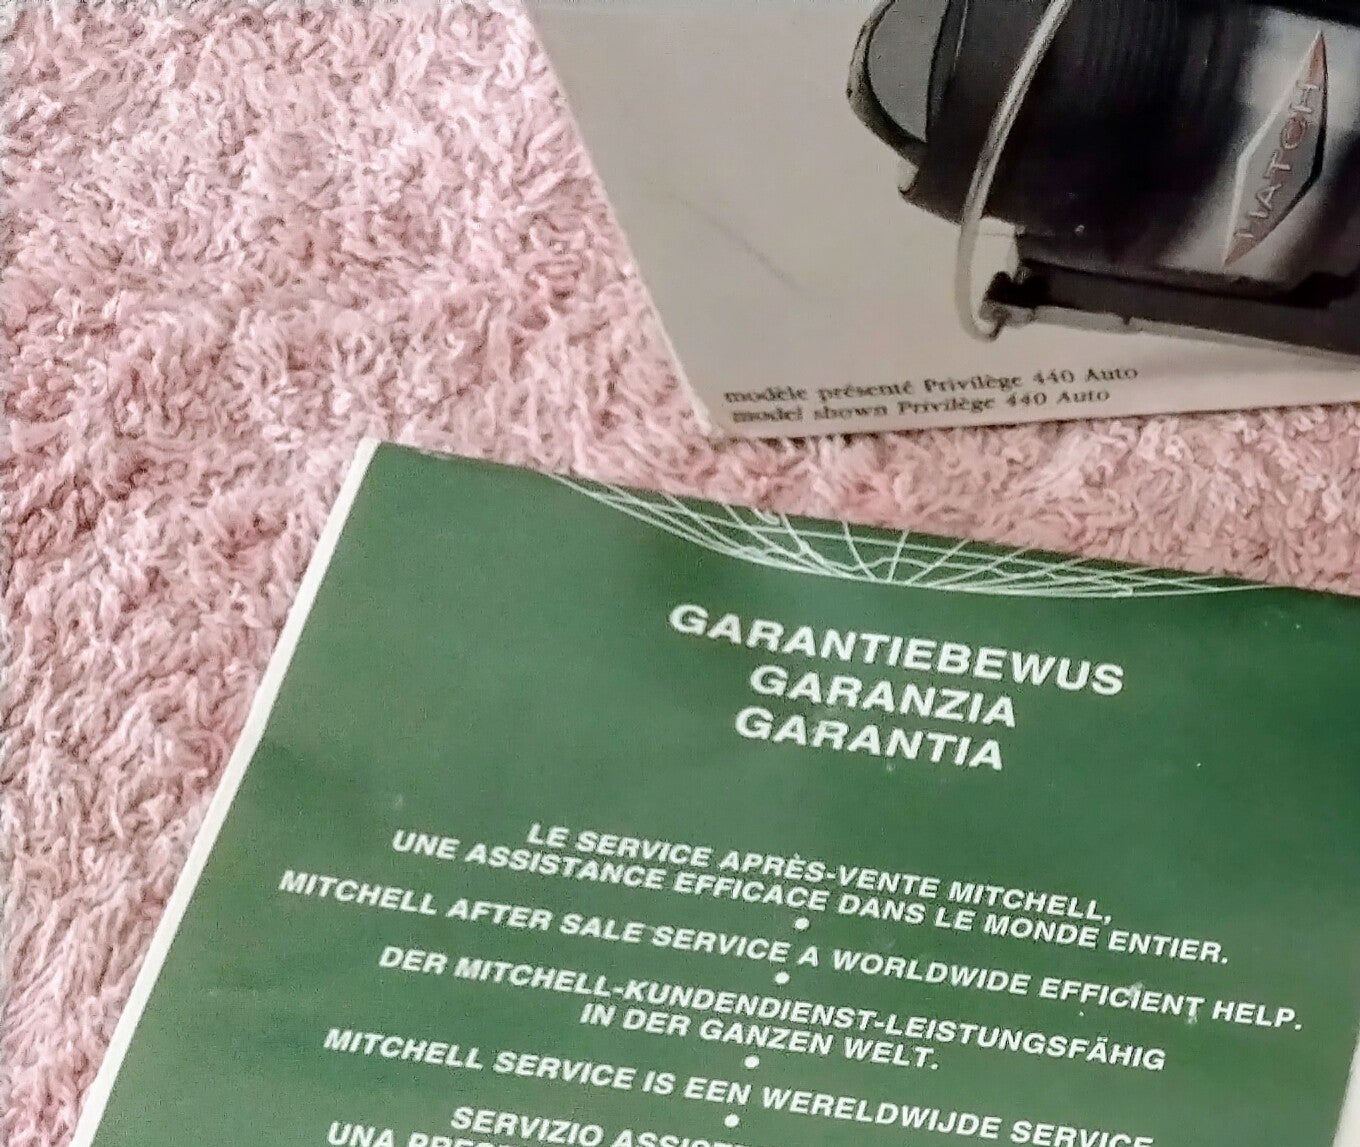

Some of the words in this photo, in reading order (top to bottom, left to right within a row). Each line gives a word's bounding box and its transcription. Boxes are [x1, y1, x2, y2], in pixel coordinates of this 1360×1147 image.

[923, 373, 1024, 393] Privilège
[1032, 368, 1076, 386] 440
[1085, 366, 1140, 383] Auto
[1005, 390, 1049, 408] 440
[1055, 389, 1111, 405] Auto
[669, 604, 1124, 695] GARANTIEBEWUS
[749, 665, 1016, 728] GARANZIA
[735, 706, 1003, 770] GARANTIA
[392, 829, 461, 860] UNE
[464, 843, 667, 890] ASSISTANCE
[673, 871, 830, 912] EFFICACE
[837, 893, 926, 925] DANS
[934, 906, 977, 931] LE
[983, 913, 1100, 948] MONDE
[1108, 930, 1228, 964] ENTIER.
[526, 823, 570, 849] LE
[574, 830, 712, 868] SERVICE
[717, 850, 941, 899] APRÈS-VENTE
[278, 869, 437, 915] MITCHELL
[447, 898, 554, 931] AFTER
[559, 913, 647, 943] SALE
[650, 925, 791, 964] SERVICE
[796, 945, 819, 967] A
[833, 949, 1032, 995] WORLDWIDE
[1038, 977, 1205, 1022] EFFICIENT
[1211, 1000, 1302, 1030] HELP.
[378, 946, 448, 975] DER
[453, 957, 1166, 1071] MITCHELL-KUNDENDIENST-LEISTUNGSFÄHIG
[580, 1002, 617, 1028] IN
[622, 1008, 692, 1037] DER
[698, 1018, 834, 1055] GANZEN
[844, 1036, 938, 1070] WELT.
[323, 1028, 484, 1070] MITCHELL
[492, 1051, 637, 1090] SERVICE
[642, 1070, 676, 1095] IS
[683, 1076, 752, 1106] EEN
[762, 1086, 1003, 1140] WERELDWIJDE
